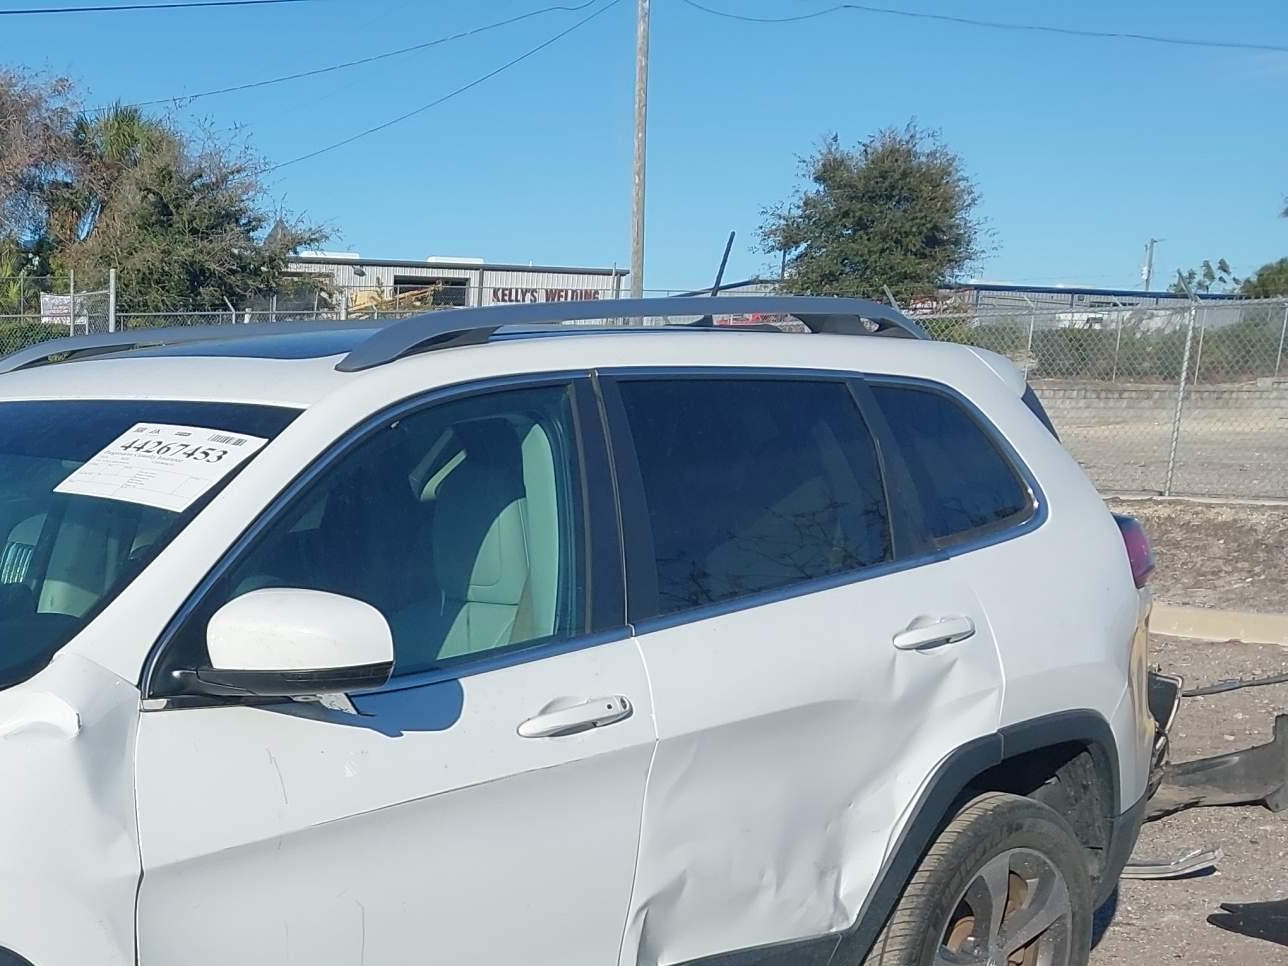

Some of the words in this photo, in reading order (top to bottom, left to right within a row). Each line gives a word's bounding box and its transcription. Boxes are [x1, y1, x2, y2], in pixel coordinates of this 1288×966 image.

[491, 287, 539, 303] KELLY'S
[545, 289, 601, 302] WELDING
[120, 438, 229, 463] 44267453
